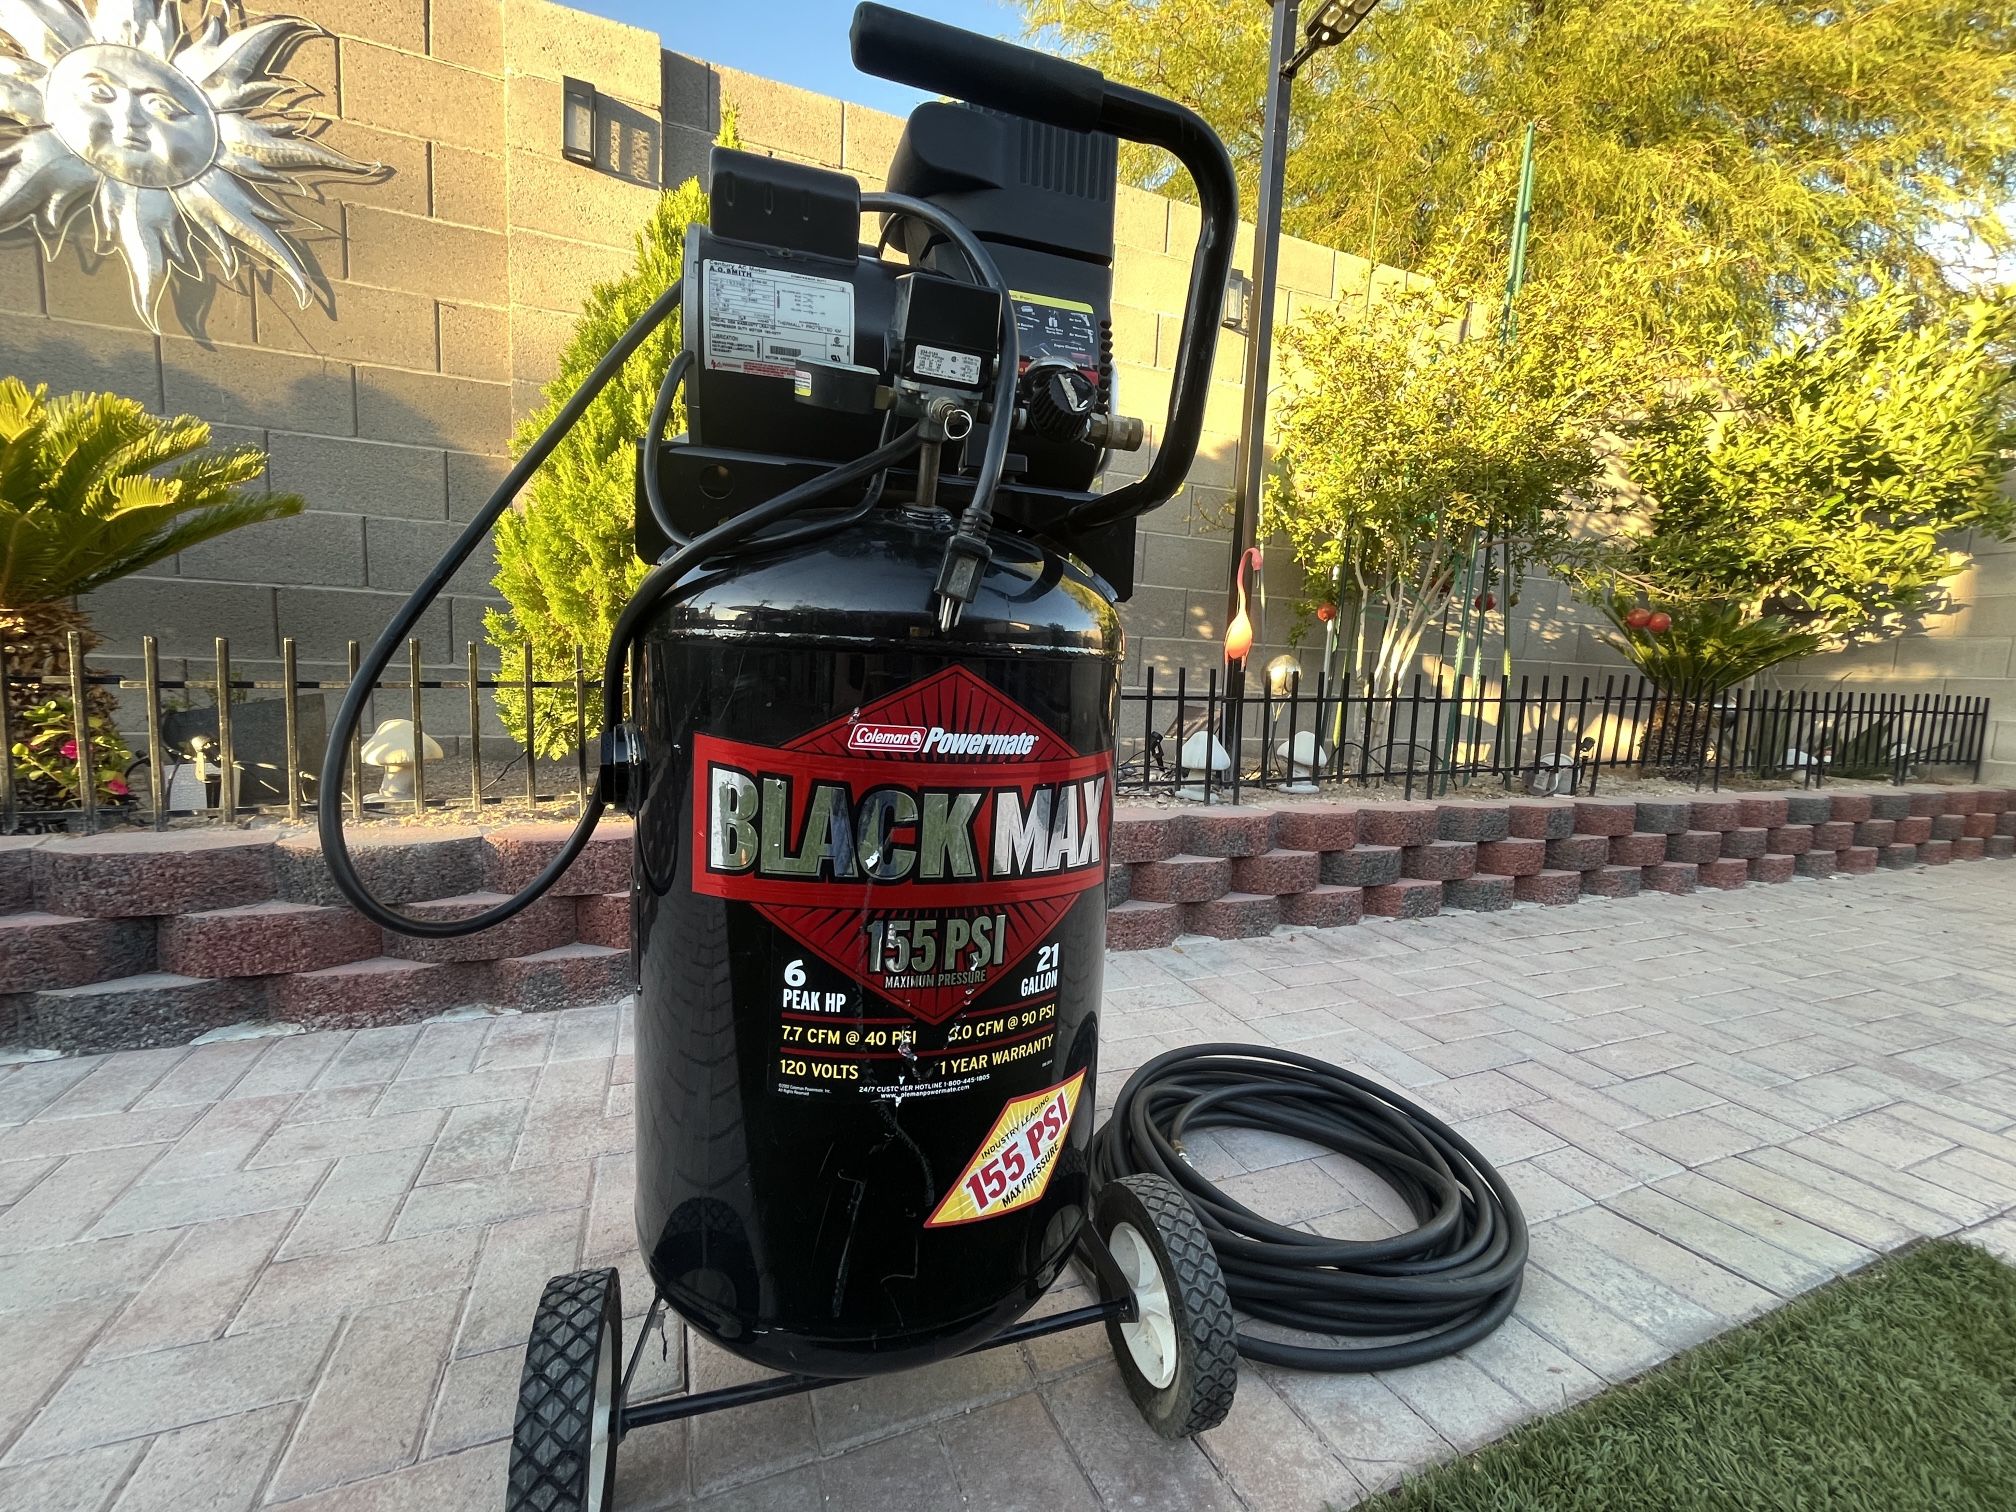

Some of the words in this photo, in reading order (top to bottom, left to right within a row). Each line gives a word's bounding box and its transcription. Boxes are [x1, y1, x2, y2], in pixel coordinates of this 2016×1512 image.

[856, 727, 909, 745] Coleman
[710, 765, 983, 881] BLACK
[990, 775, 1108, 876] MAX
[867, 919, 937, 973] 155
[944, 914, 1006, 971] PSI
[1037, 942, 1059, 973] 21
[784, 959, 807, 987] 6
[884, 974, 935, 989] MAXIMUM
[937, 969, 986, 987] PRESSURE
[1021, 968, 1058, 997] GALLON
[783, 988, 821, 1011] PEAK
[825, 992, 847, 1013] HP
[976, 1018, 1004, 1037] CFM
[1007, 1016, 1018, 1030] @
[1021, 1010, 1036, 1027] 90
[1039, 1003, 1055, 1022] PSI
[782, 1025, 803, 1041] 7.7
[807, 1028, 840, 1045] CFM
[846, 1030, 860, 1046] @
[865, 1031, 887, 1046] 40
[892, 1030, 917, 1046] PSI
[940, 1061, 946, 1075] 1
[951, 1054, 988, 1074] YEAR
[992, 1033, 1054, 1066] WARRANTY
[780, 1059, 806, 1076] 120
[811, 1063, 859, 1080] VOLTS
[914, 1081, 943, 1091] HOTLINE
[981, 1126, 1020, 1160] INDUSTRY
[1021, 1095, 1050, 1128] LEADING
[965, 1142, 1026, 1210] 155
[1026, 1092, 1068, 1161] PSI
[1001, 1185, 1021, 1208] MAX
[1022, 1140, 1060, 1189] PRESSURE
